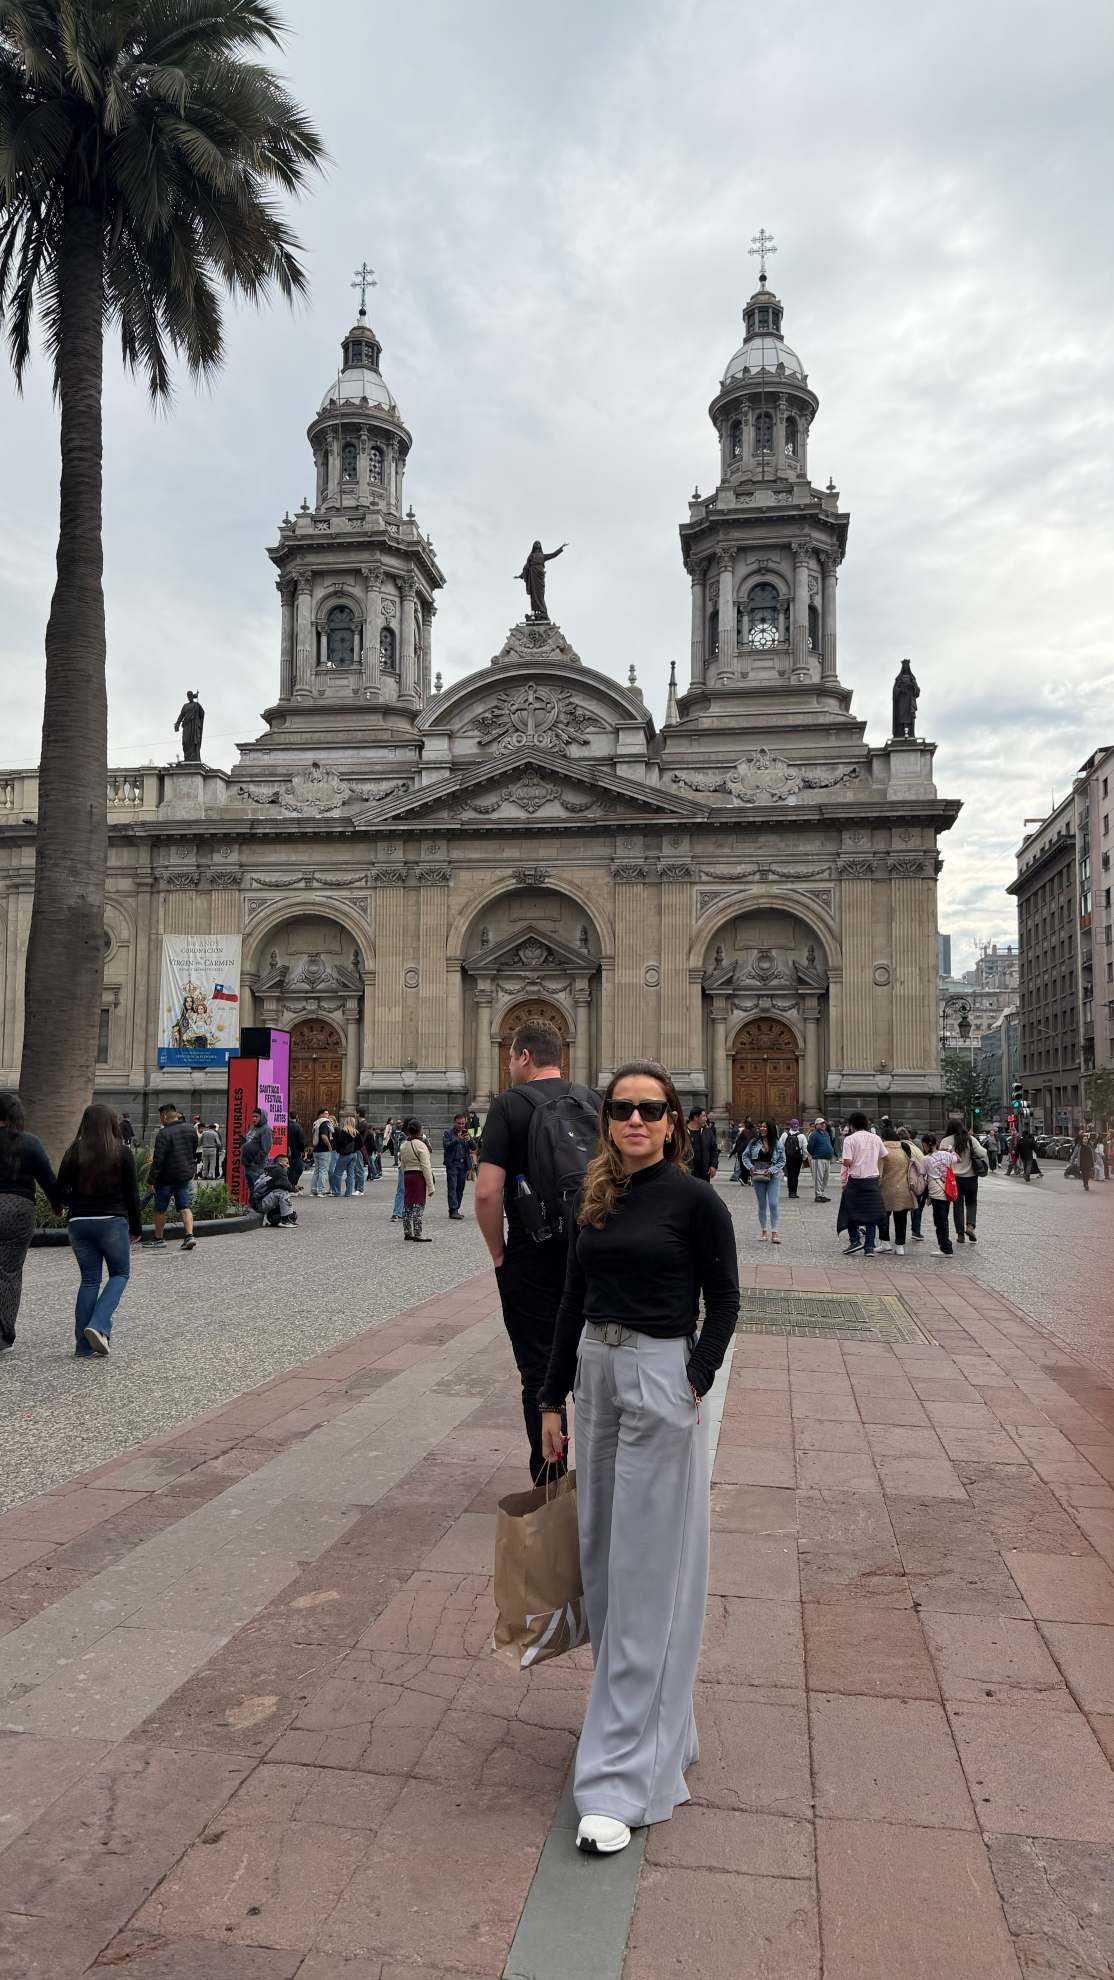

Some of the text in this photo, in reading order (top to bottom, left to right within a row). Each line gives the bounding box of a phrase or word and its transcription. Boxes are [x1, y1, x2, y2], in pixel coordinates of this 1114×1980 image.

[259, 1084, 279, 1094] SANTIAGO
[265, 1094, 282, 1104] FESTIVAL
[232, 1087, 244, 1157] CULTURALES
[274, 1113, 287, 1122] ARTES
[231, 1159, 241, 1196] RUTAS
